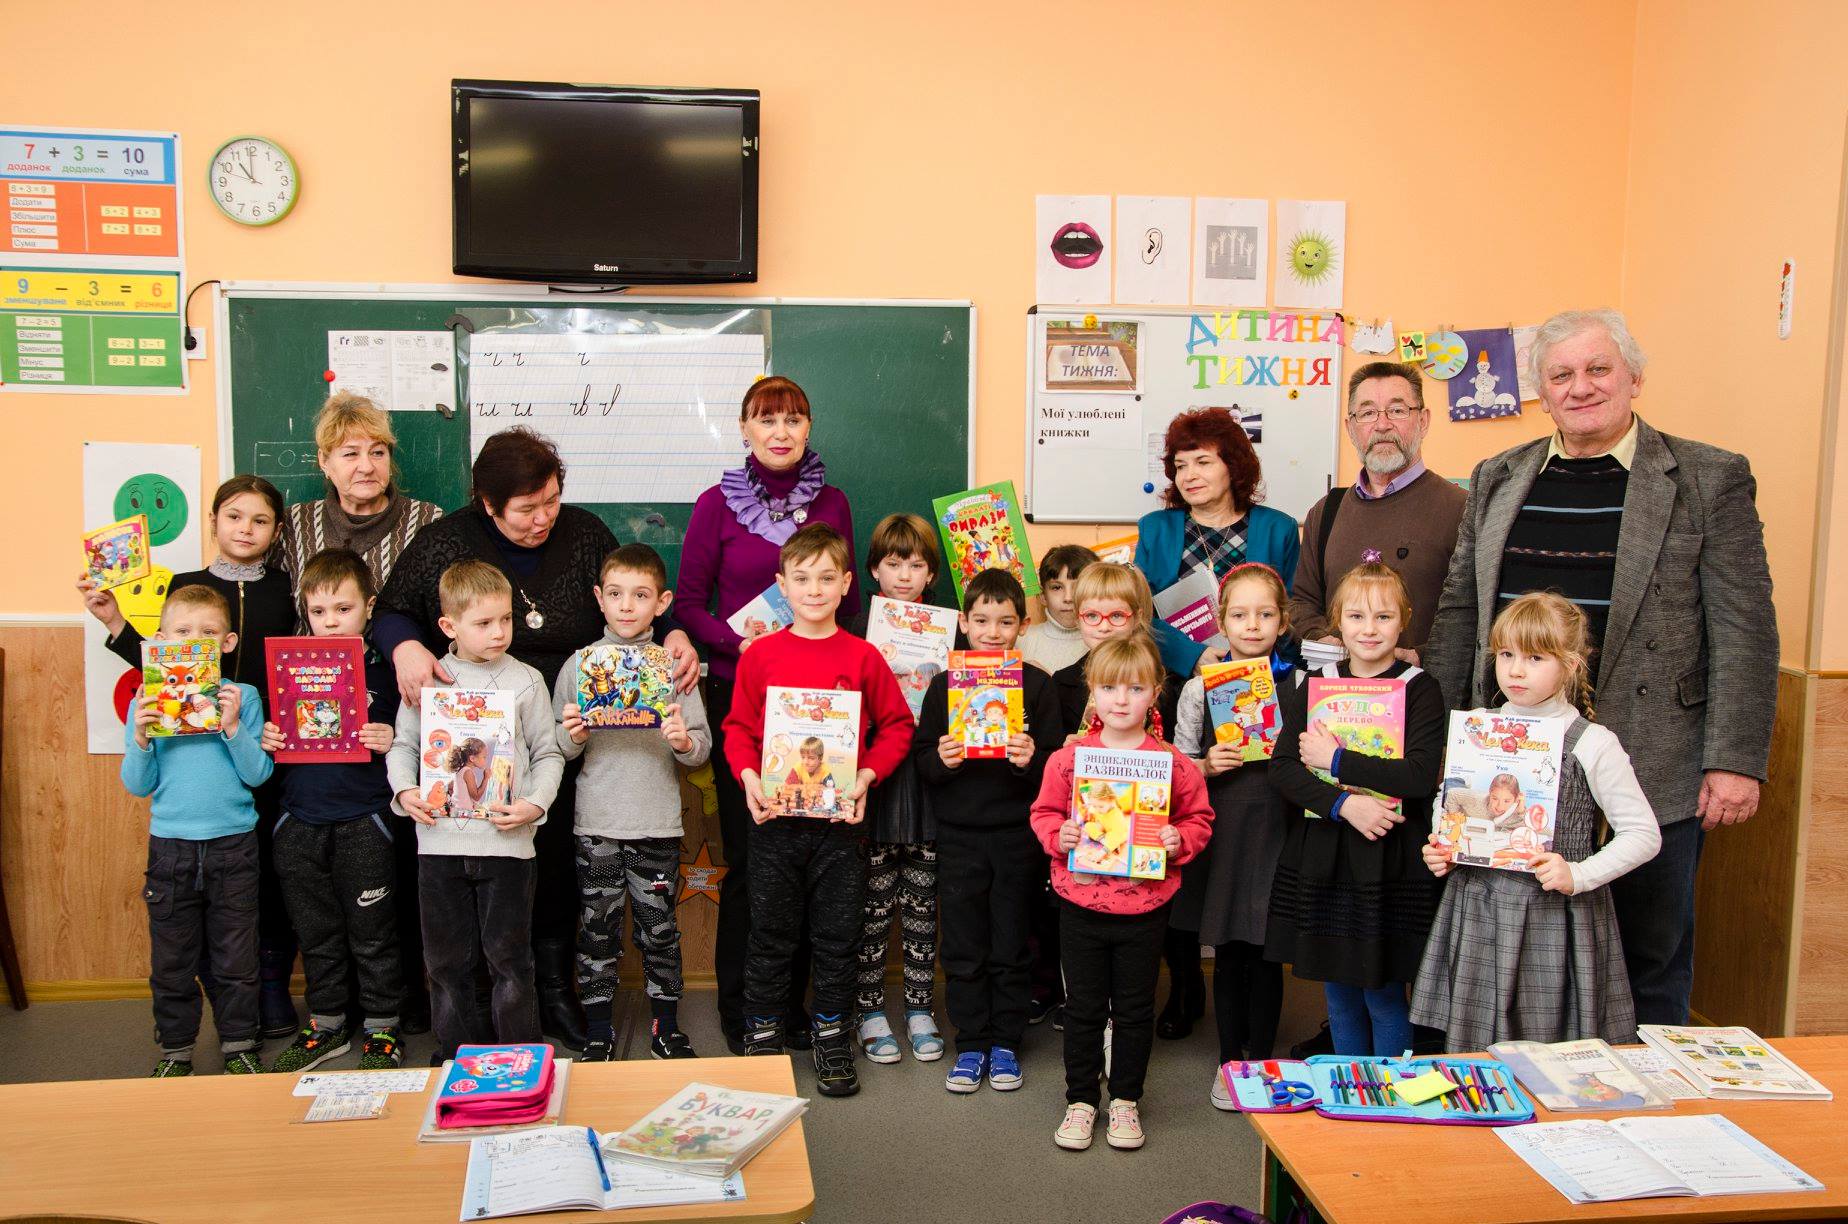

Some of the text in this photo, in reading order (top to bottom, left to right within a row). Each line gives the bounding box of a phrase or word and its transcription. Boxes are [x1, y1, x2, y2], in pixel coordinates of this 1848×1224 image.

[24, 144, 35, 160] 7
[73, 145, 85, 162] 3
[122, 148, 145, 164] 10
[231, 151, 240, 161] 11
[265, 152, 270, 161] 1
[7, 162, 149, 177] доданок доданок сума
[274, 160, 283, 172] 2
[219, 176, 227, 188] 9
[280, 175, 289, 187] 3
[225, 191, 233, 203] 8
[277, 191, 285, 200] 4
[237, 203, 245, 213] 7
[252, 206, 261, 217] 6
[267, 201, 276, 213] 5
[593, 263, 619, 272] Saturn
[18, 278, 29, 294] 9
[89, 280, 99, 296] 3
[152, 282, 163, 297] 6
[1185, 310, 1345, 353] ДИТИНА
[1070, 345, 1110, 357] ТЕМА
[1062, 365, 1118, 377] ТИЖНЯ:
[1186, 355, 1331, 389] ТИЖНЯ
[1041, 408, 1126, 421] Мої улюблені
[1040, 429, 1090, 437] книжки
[1084, 754, 1168, 769] ЭНЦИКЛОПЕДИЯ
[1084, 764, 1167, 780] РАЗВИВАЛОК
[361, 886, 386, 899] NIKE
[678, 1096, 774, 1120] БУКВАР
